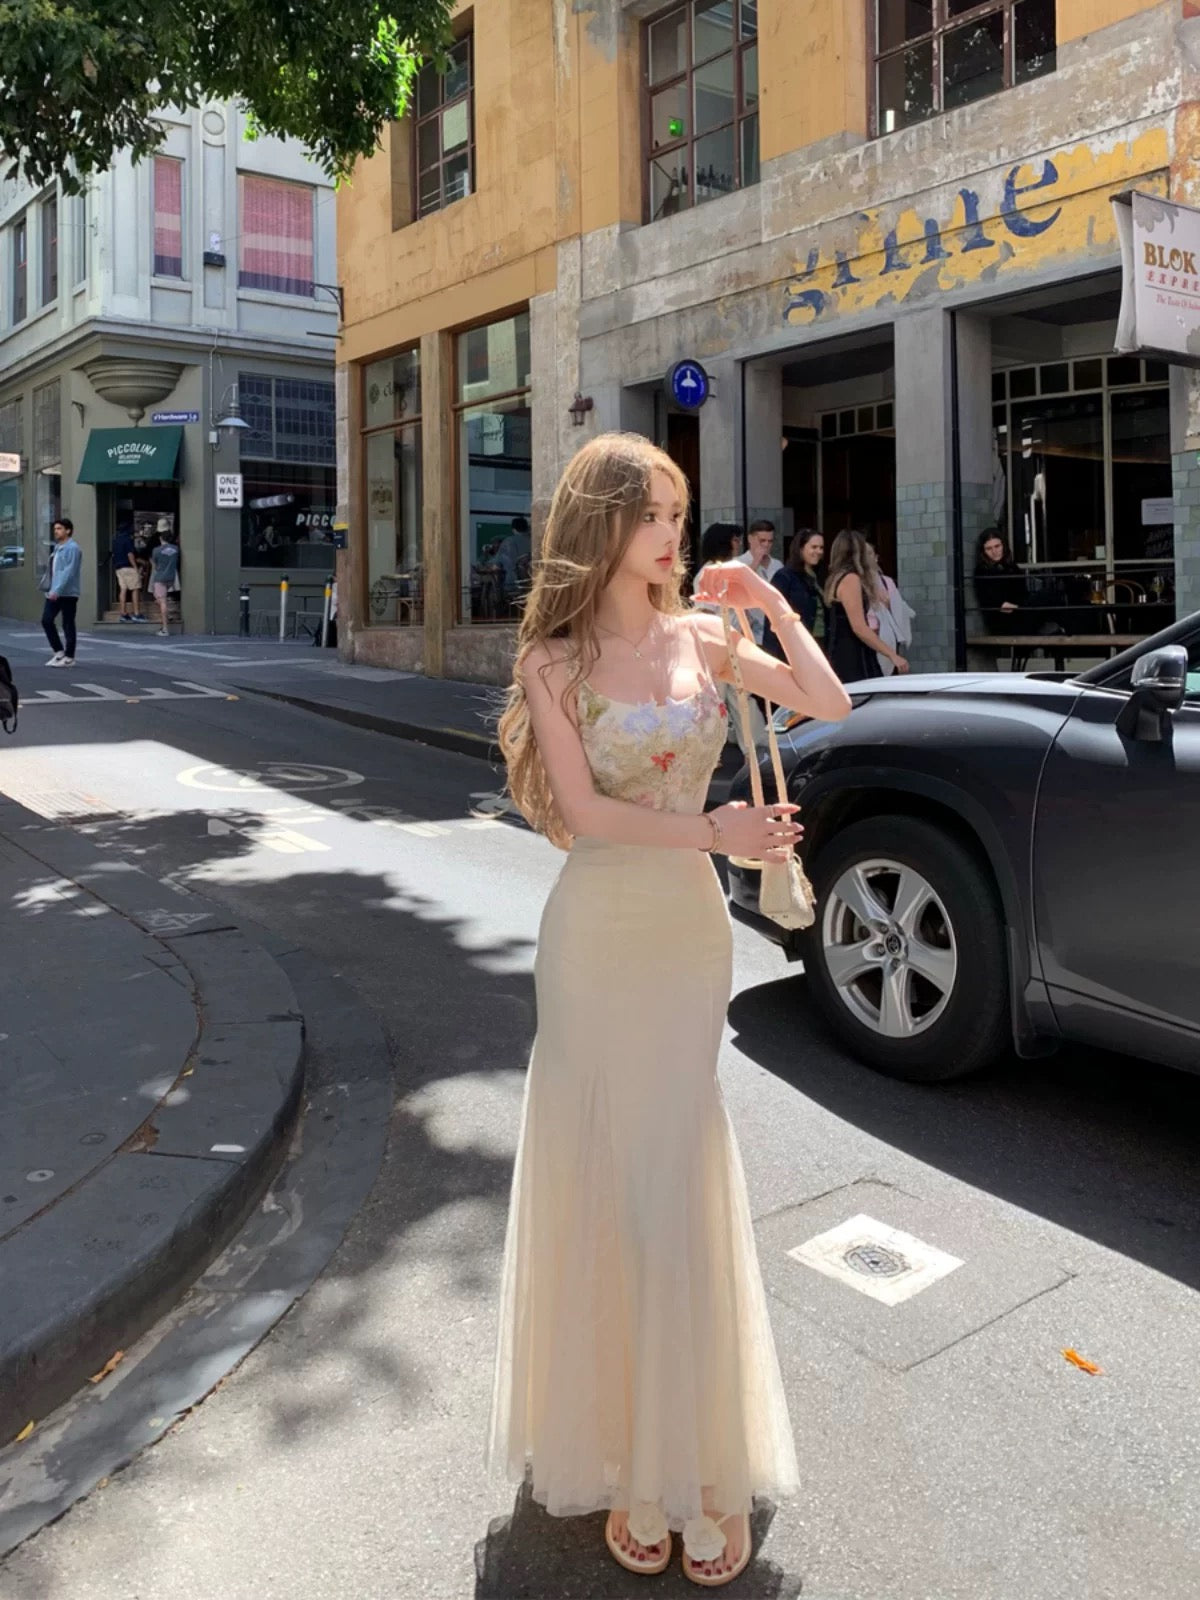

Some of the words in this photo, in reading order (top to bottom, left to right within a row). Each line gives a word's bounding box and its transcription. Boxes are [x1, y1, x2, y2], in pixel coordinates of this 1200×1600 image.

[1143, 242, 1198, 275] BLOK
[107, 443, 157, 458] PICCOLINA
[219, 476, 238, 485] ONE
[218, 487, 239, 495] WAY
